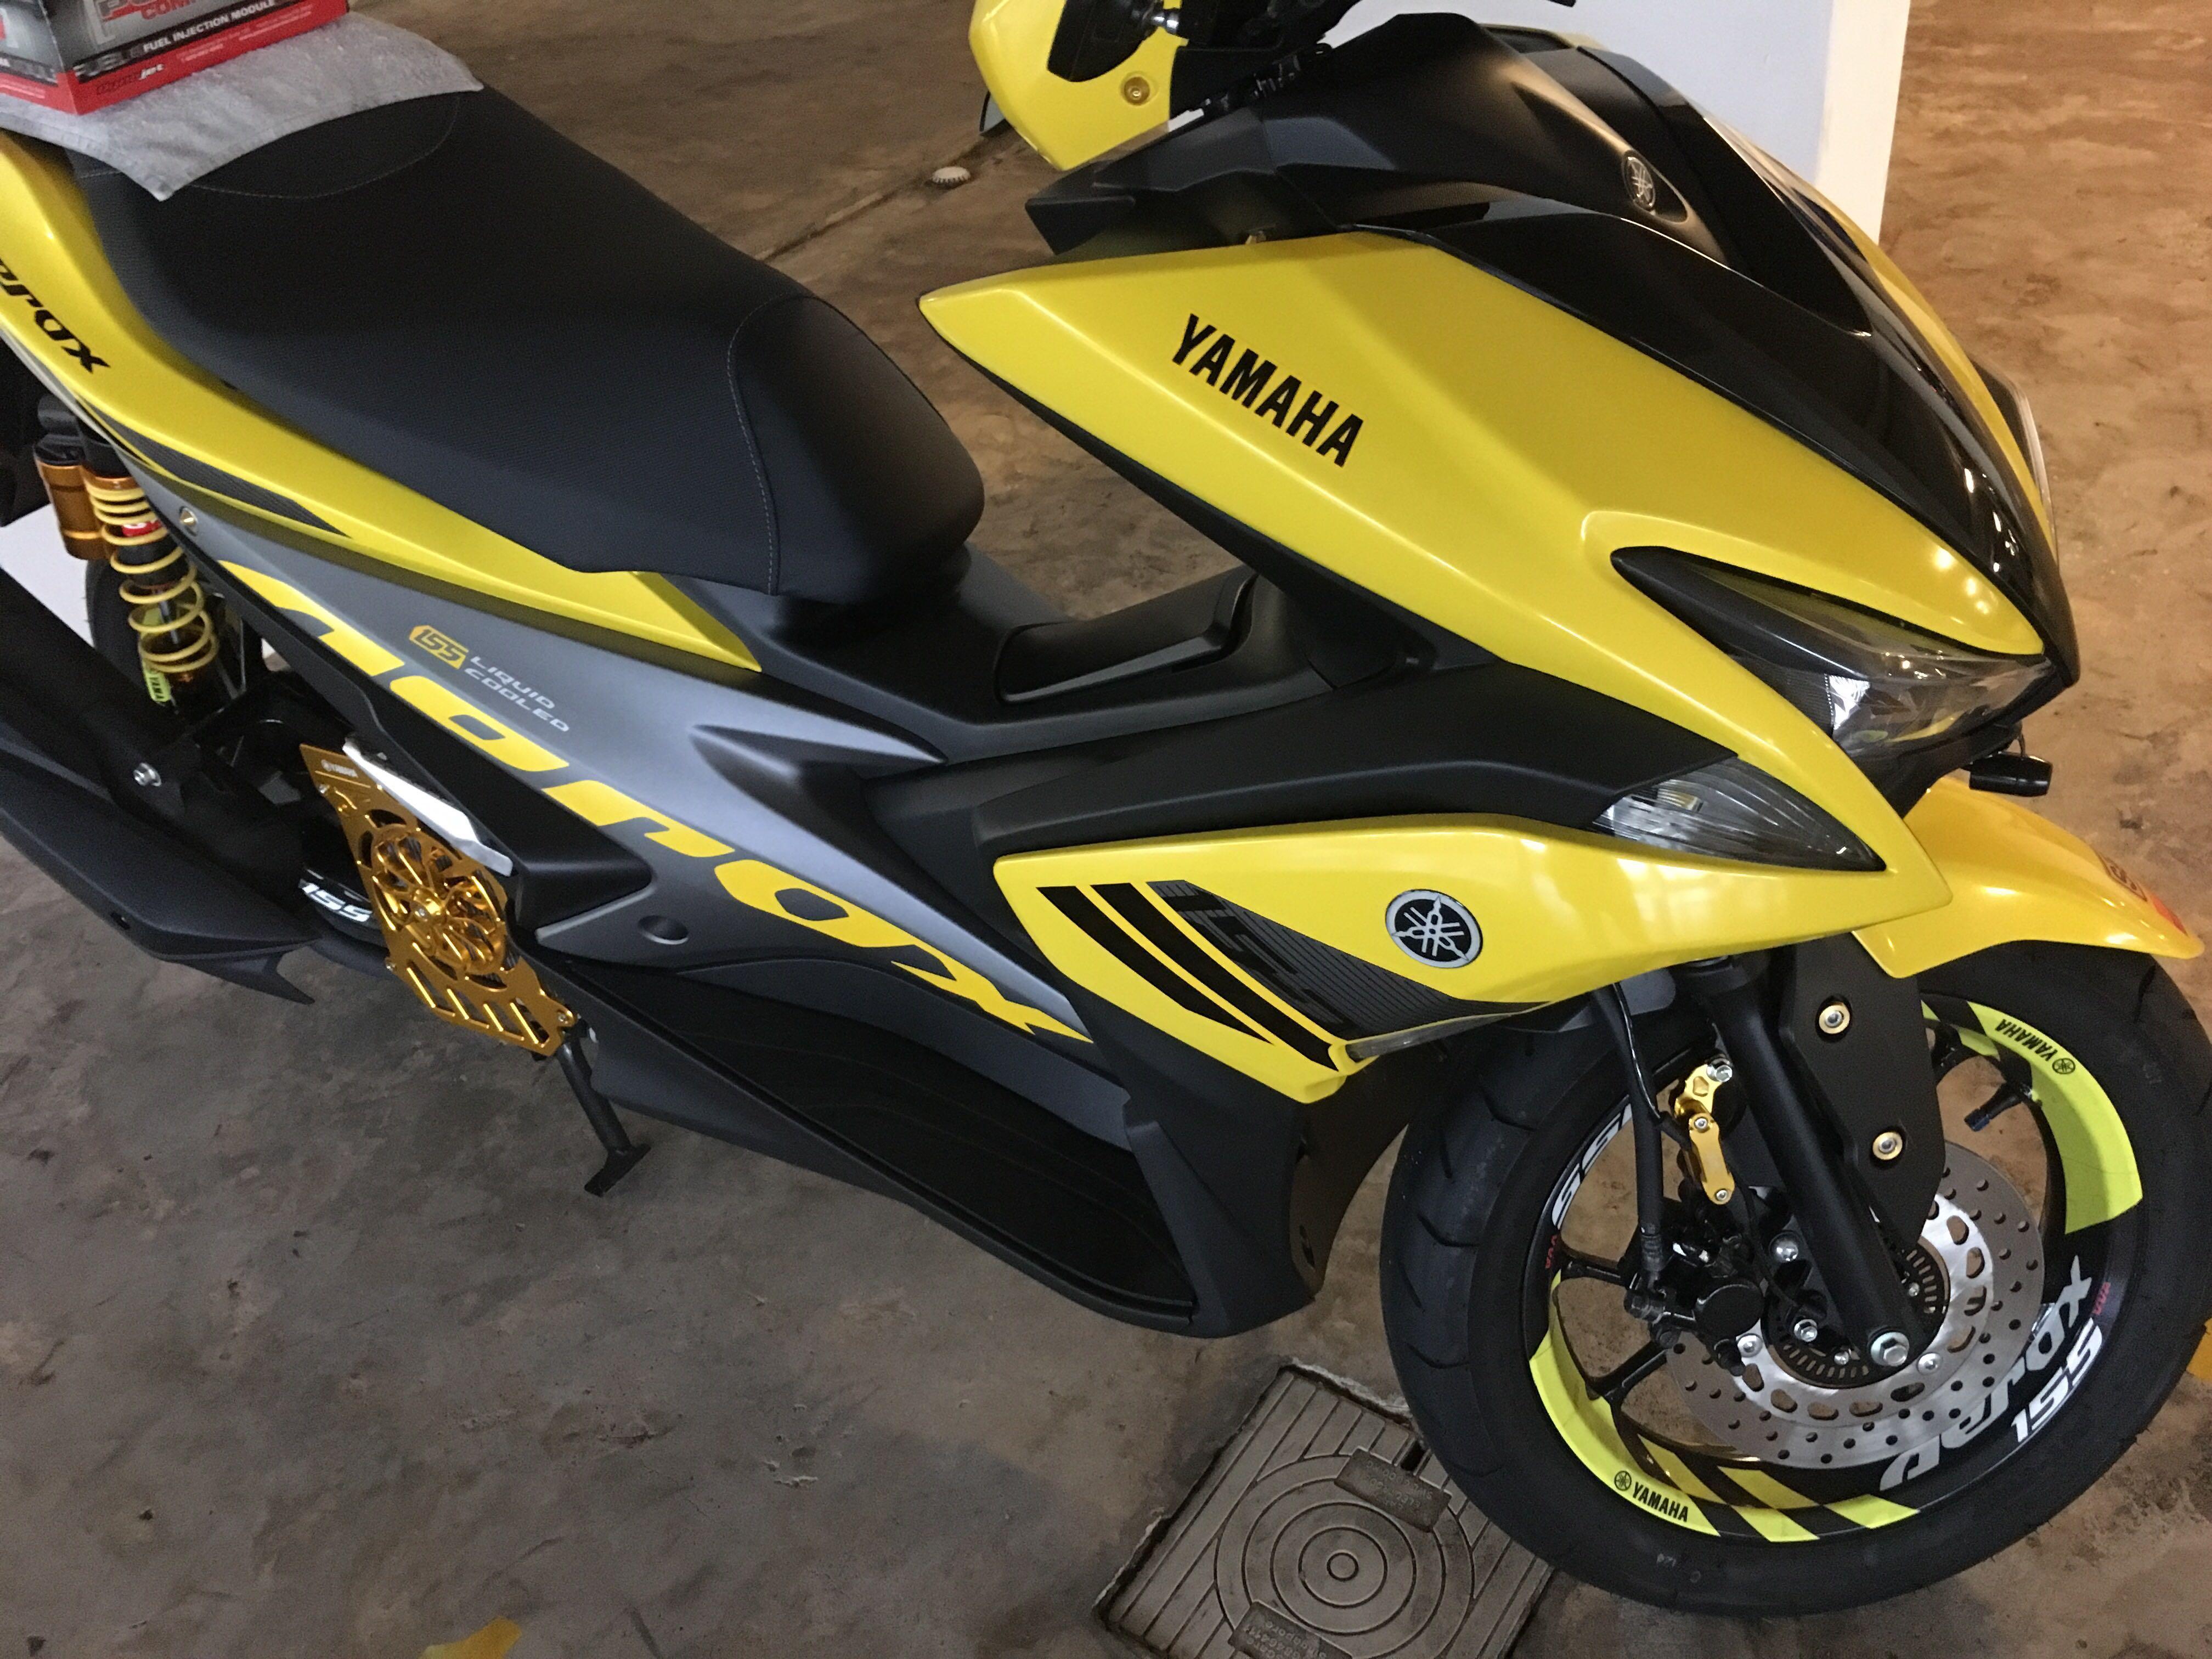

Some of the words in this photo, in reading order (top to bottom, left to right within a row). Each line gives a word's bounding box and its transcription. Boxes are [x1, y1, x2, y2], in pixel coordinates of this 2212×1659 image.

[143, 37, 171, 52] FUEL
[172, 15, 229, 42] INJECTION
[1172, 313, 1364, 468] YAMAHA
[412, 628, 468, 662] 155
[464, 668, 570, 732] COOLED
[470, 656, 555, 709] LIQUID
[1995, 1019, 2058, 1062] YAMAHA
[2011, 1317, 2103, 1443] 155
[1632, 1481, 1689, 1523] YAMAHA
